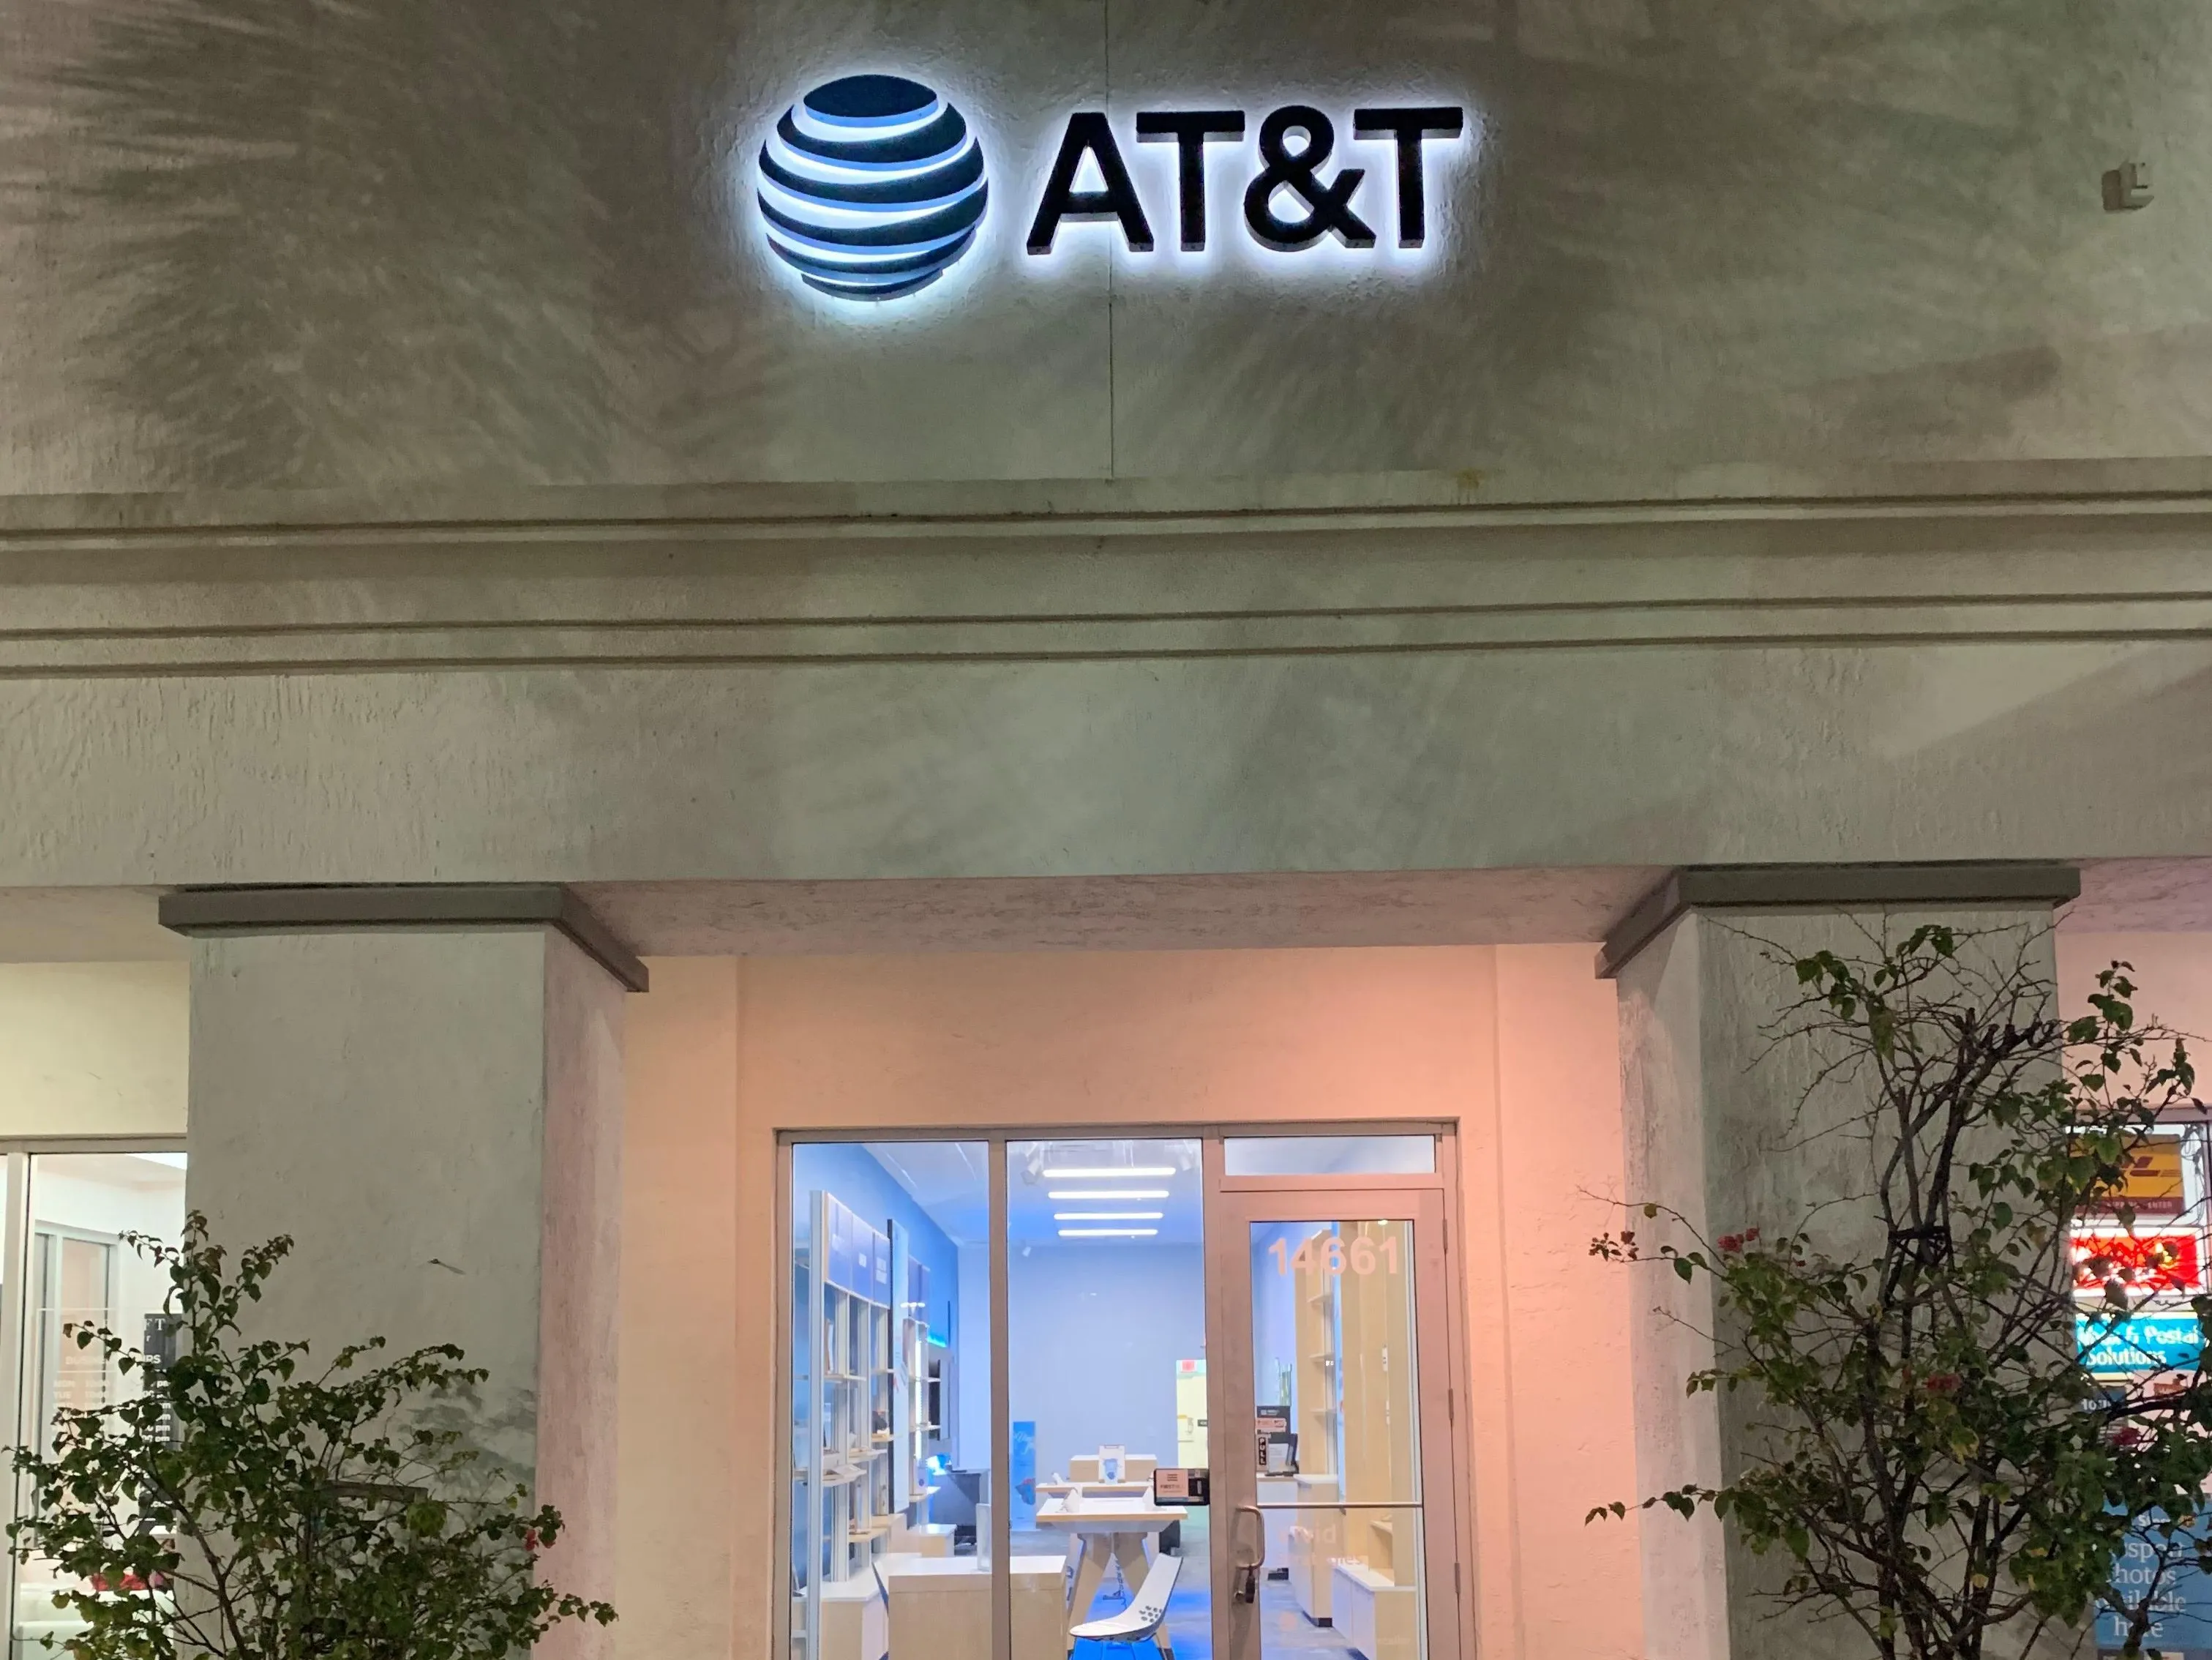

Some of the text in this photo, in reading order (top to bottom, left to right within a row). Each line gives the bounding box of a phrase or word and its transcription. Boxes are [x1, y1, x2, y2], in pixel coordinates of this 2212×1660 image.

[1027, 105, 1463, 255] AT&T
[1268, 1236, 1398, 1275] 14661
[2107, 1563, 2177, 1585] hotos
